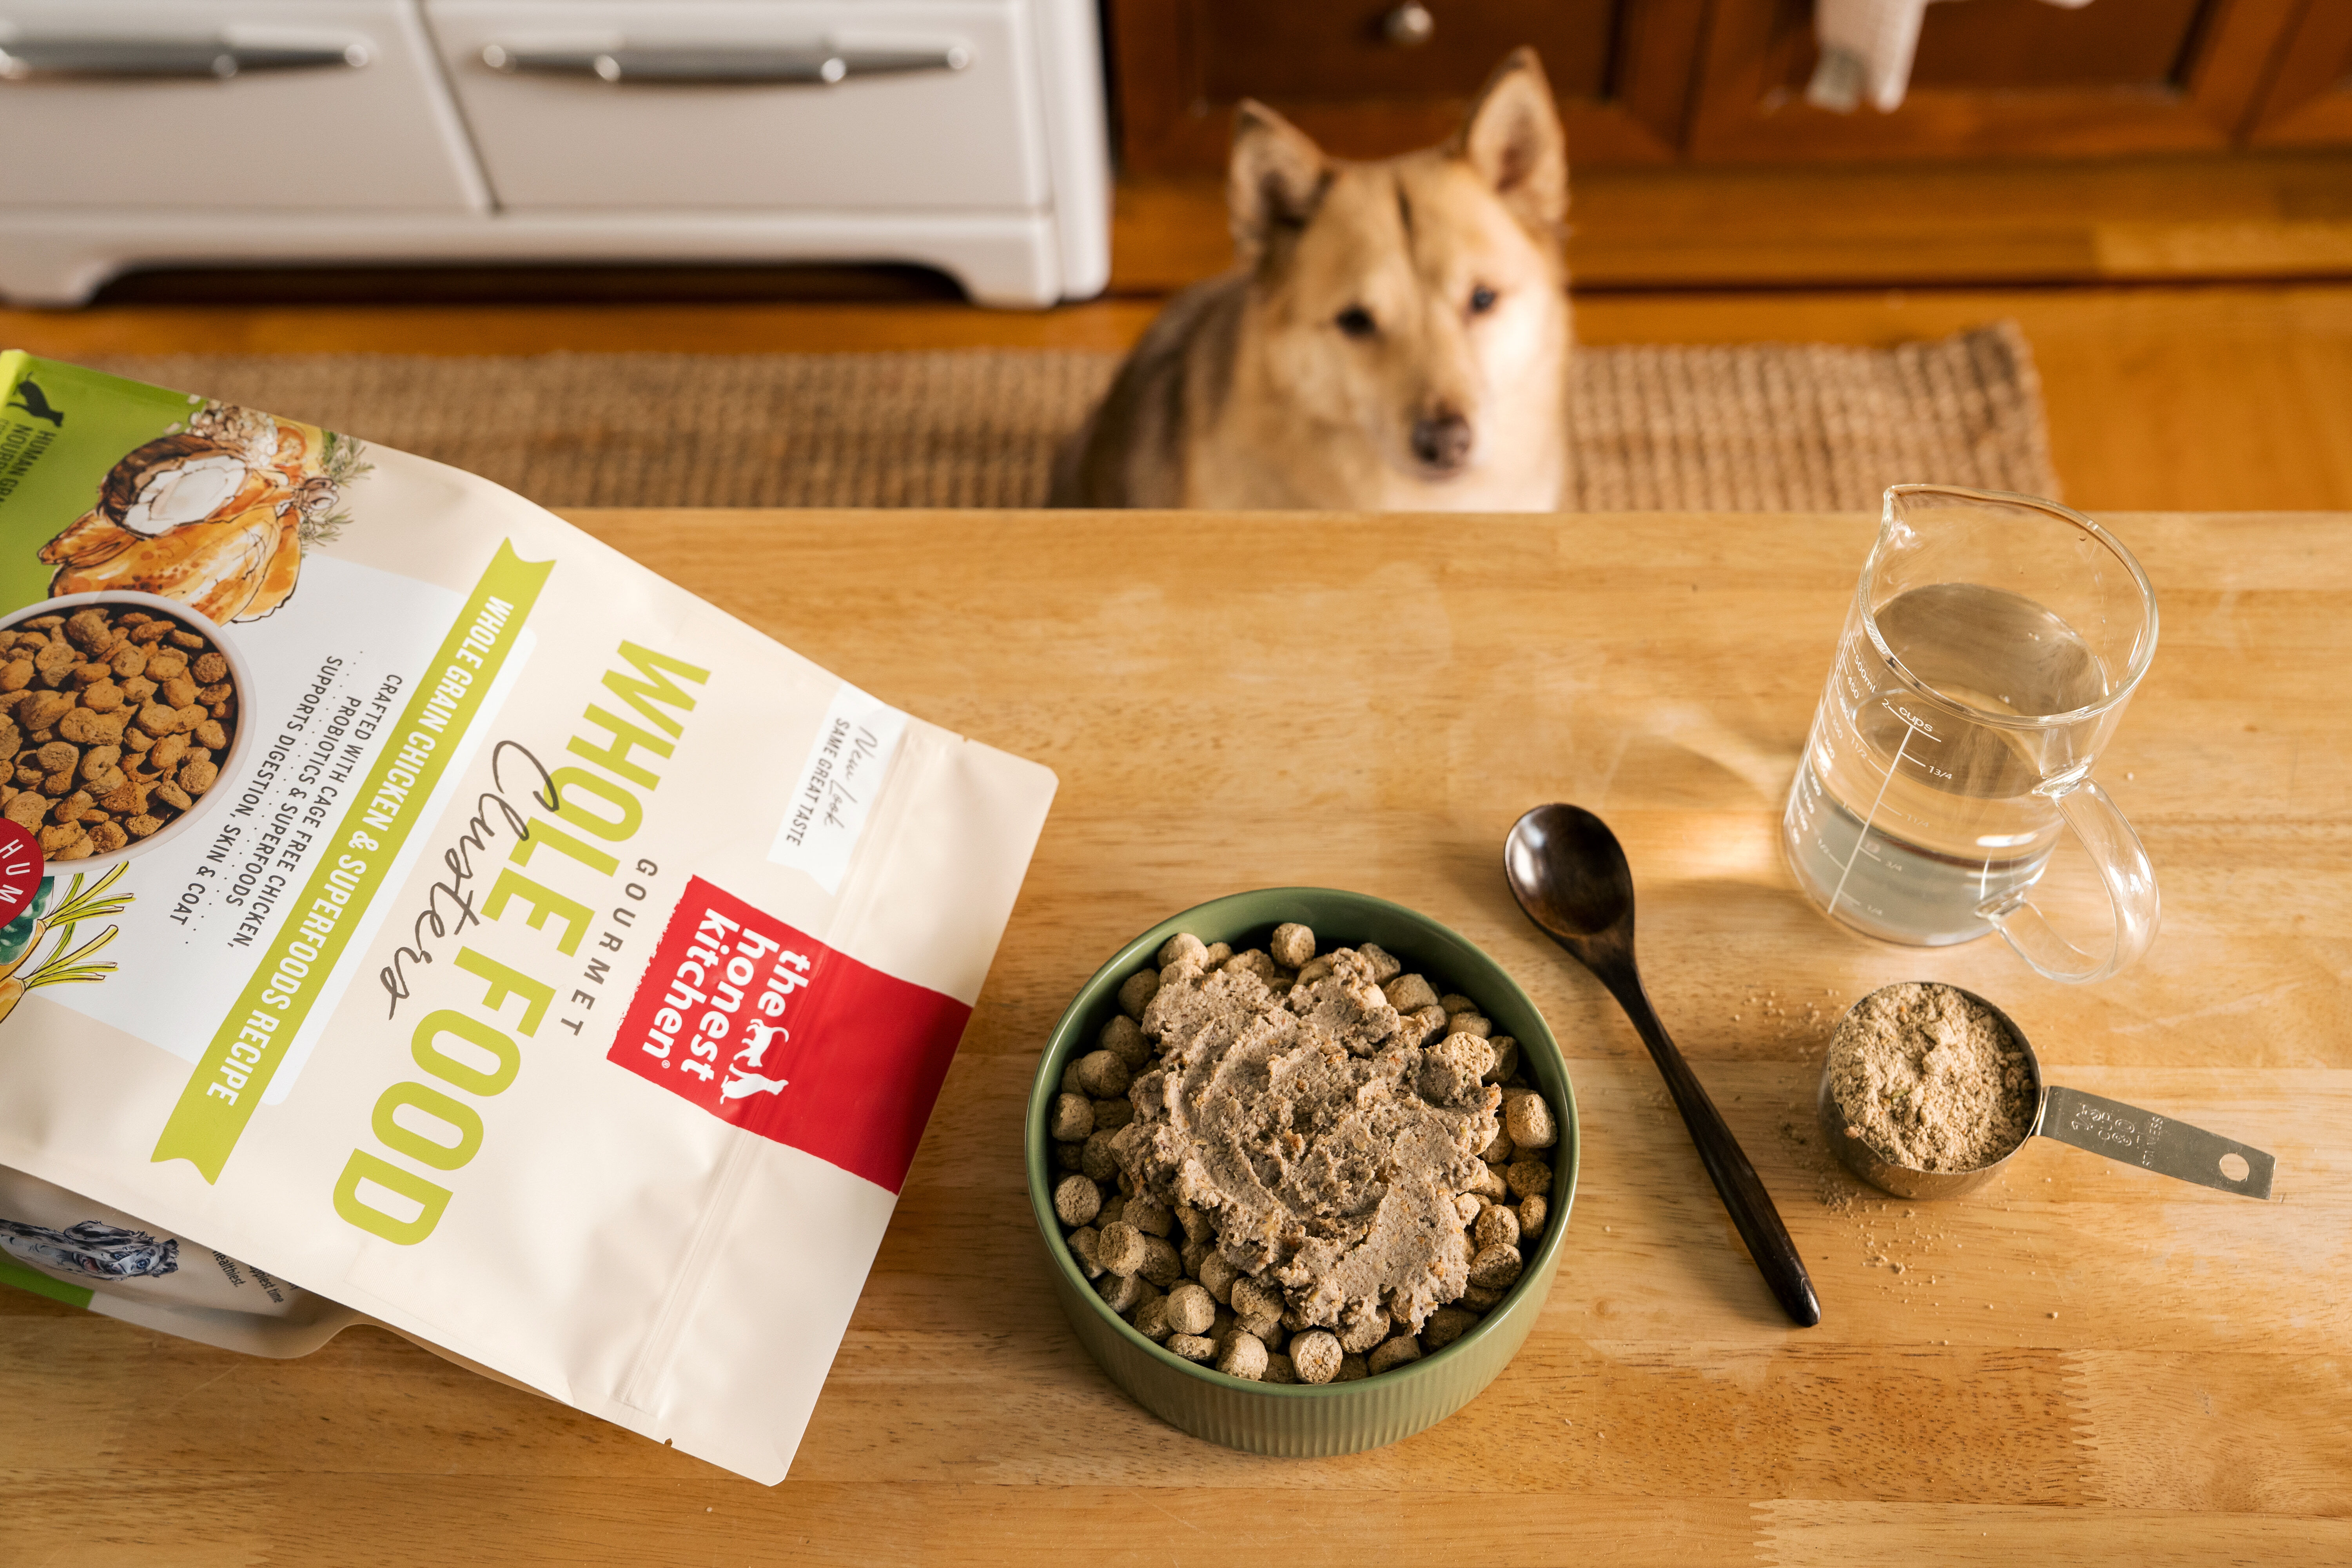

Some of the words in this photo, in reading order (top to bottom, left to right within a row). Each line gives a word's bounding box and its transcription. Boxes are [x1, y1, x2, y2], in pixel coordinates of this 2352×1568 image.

[456, 595, 514, 669] WHOLE
[287, 656, 343, 733] SUPPORTS
[418, 665, 473, 733] GRAIN
[1848, 677, 1859, 699] 450
[1855, 654, 1875, 693] 500ml
[355, 674, 403, 740] CRAFTED
[824, 717, 850, 758] SAME
[1882, 698, 1889, 708] 2
[1899, 707, 1933, 732] cups
[298, 696, 362, 785] PROBIOTICS
[329, 747, 364, 783] WITH
[230, 734, 296, 818] DIGESTION,
[289, 787, 307, 799] &
[303, 786, 338, 828] CAGE
[362, 731, 436, 831] CHICKEN
[480, 640, 711, 958] WHOLE
[804, 757, 833, 804] GREAT
[824, 779, 858, 829] Look
[206, 824, 241, 863] SKIN
[225, 802, 298, 907] SUPERFOODS
[276, 830, 312, 872] FREE
[348, 830, 379, 851] &
[786, 804, 814, 846] TASTE
[170, 883, 205, 925] COAT
[196, 865, 216, 878] &
[380, 740, 559, 1020] Clusters
[227, 875, 286, 947] CHICKEN,
[261, 855, 367, 1009] SUPERFOODS
[561, 858, 658, 1036] GOURMET
[681, 928, 780, 1082] honest
[757, 951, 811, 1017] the
[207, 1009, 280, 1106] RECIPE
[333, 946, 557, 1245] FOOD
[249, 1266, 276, 1289] ppiest
[267, 1288, 284, 1303] time
